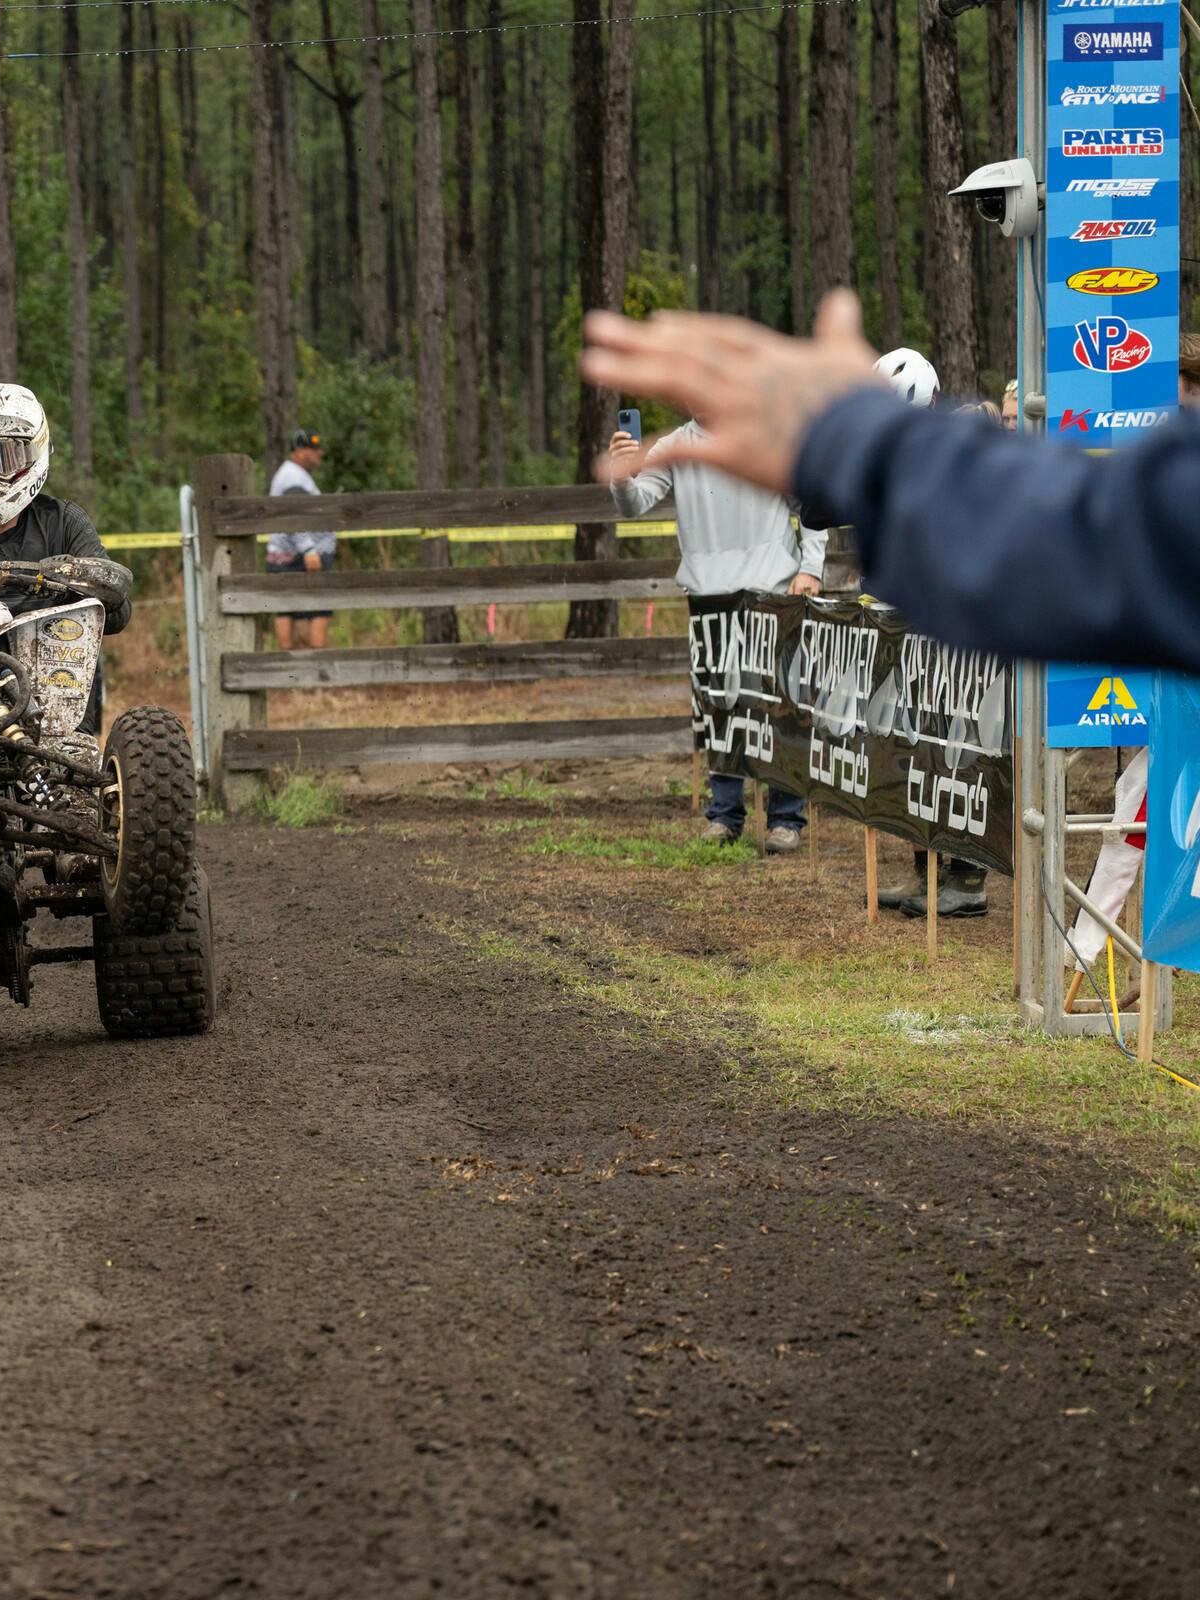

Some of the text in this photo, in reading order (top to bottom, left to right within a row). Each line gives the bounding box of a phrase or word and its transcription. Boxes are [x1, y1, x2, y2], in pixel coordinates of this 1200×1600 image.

[1092, 31, 1152, 48] YAMAHA
[1076, 85, 1108, 94] ROCKY
[1108, 84, 1161, 94] MOUNTAIN
[1063, 129, 1162, 145] PARTS
[1063, 144, 1162, 155] UNLIMITED
[1065, 178, 1160, 192] MOOSE
[1074, 220, 1155, 240] AMSOIL
[1068, 271, 1158, 288] FMF
[1075, 316, 1128, 372] VP
[1111, 345, 1151, 366] Racing
[1094, 411, 1170, 428] KENDA
[799, 619, 879, 700] SPECIALIZED
[1077, 711, 1148, 727] ARMA
